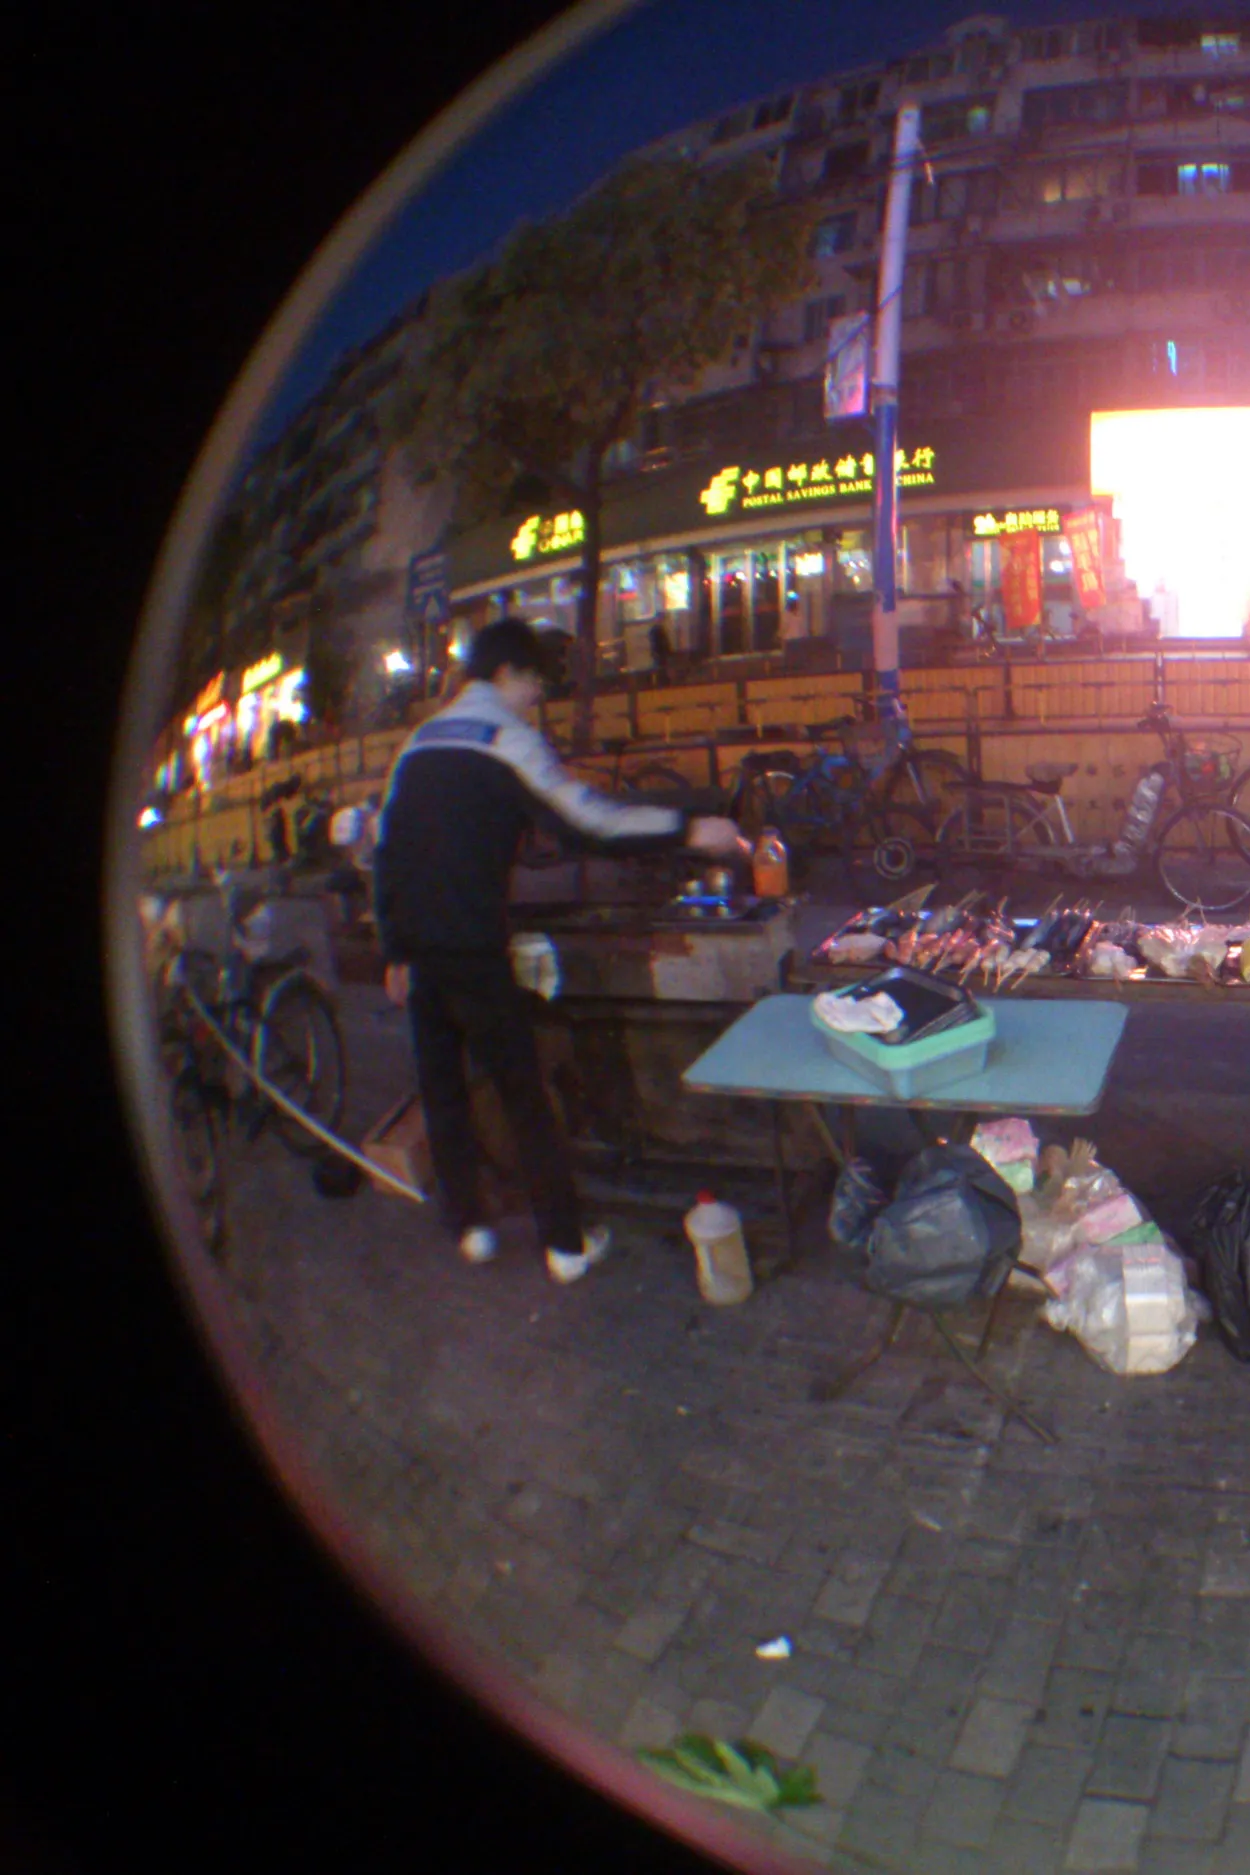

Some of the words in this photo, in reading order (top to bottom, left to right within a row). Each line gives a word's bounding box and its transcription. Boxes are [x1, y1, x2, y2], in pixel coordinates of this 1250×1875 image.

[742, 492, 783, 508] POSTAL
[786, 486, 836, 501] SAVINGS
[839, 480, 872, 493] BANK
